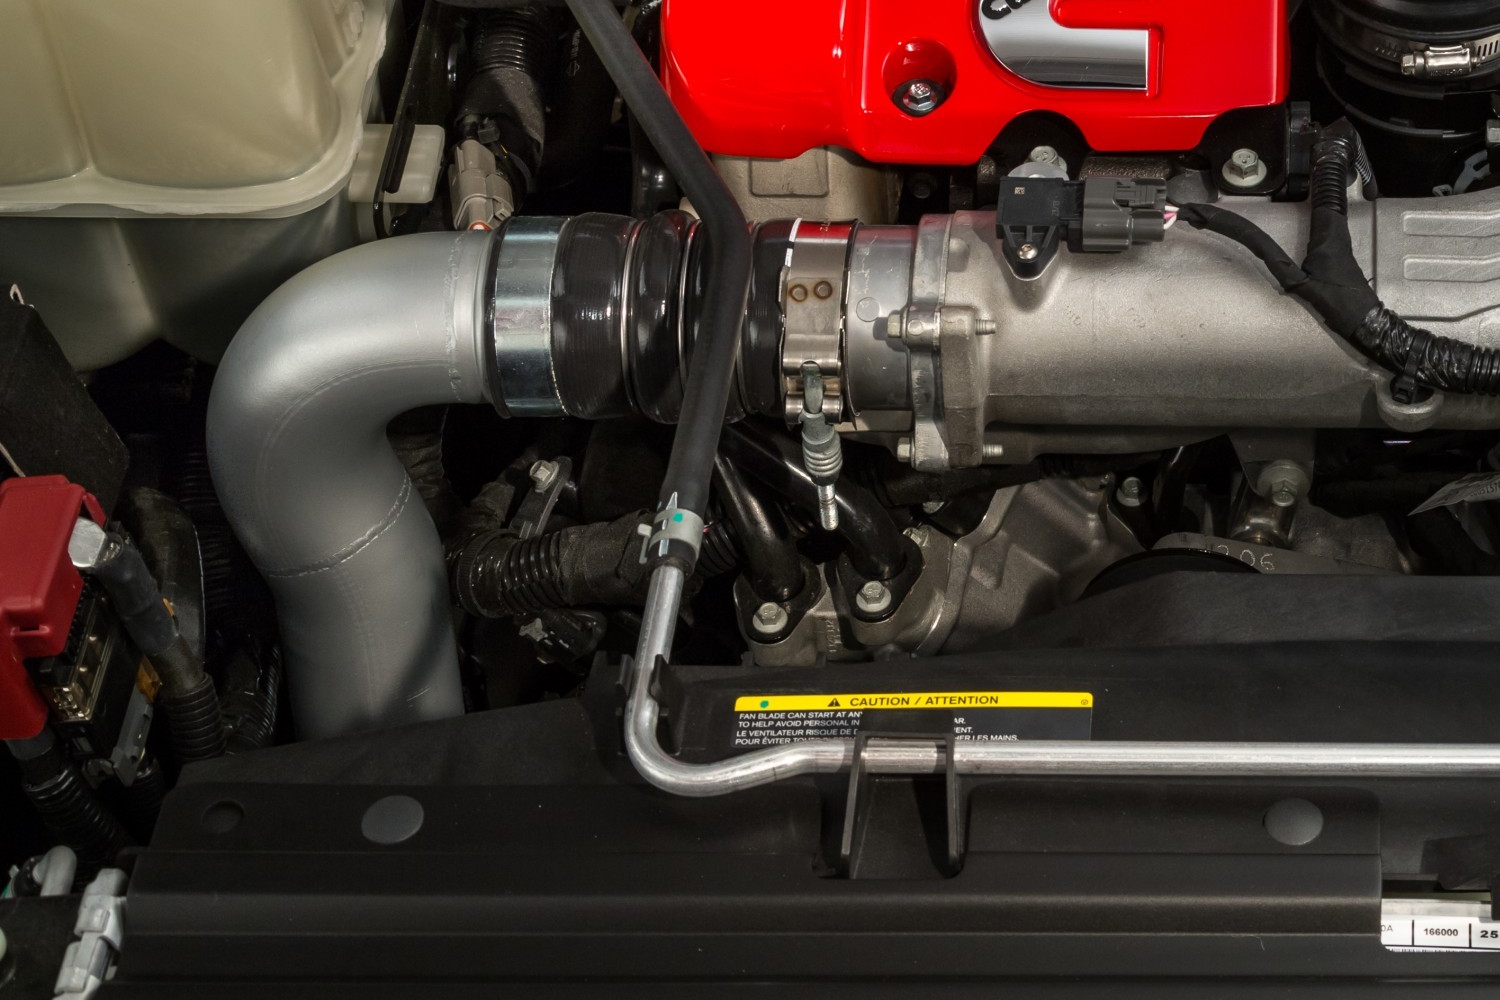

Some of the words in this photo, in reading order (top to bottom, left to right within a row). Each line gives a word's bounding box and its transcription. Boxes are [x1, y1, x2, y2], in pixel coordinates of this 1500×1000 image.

[850, 697, 910, 707] CAUTION
[925, 695, 999, 705] ATTENTION
[758, 712, 786, 720] BLADE
[808, 711, 836, 719] START
[752, 720, 775, 728] HELP
[775, 720, 802, 728] AVOID
[749, 729, 804, 737] VENTILATEUR
[806, 728, 839, 736] RISQUE
[762, 736, 791, 745] ÉVITER
[1424, 928, 1459, 937] 166000
